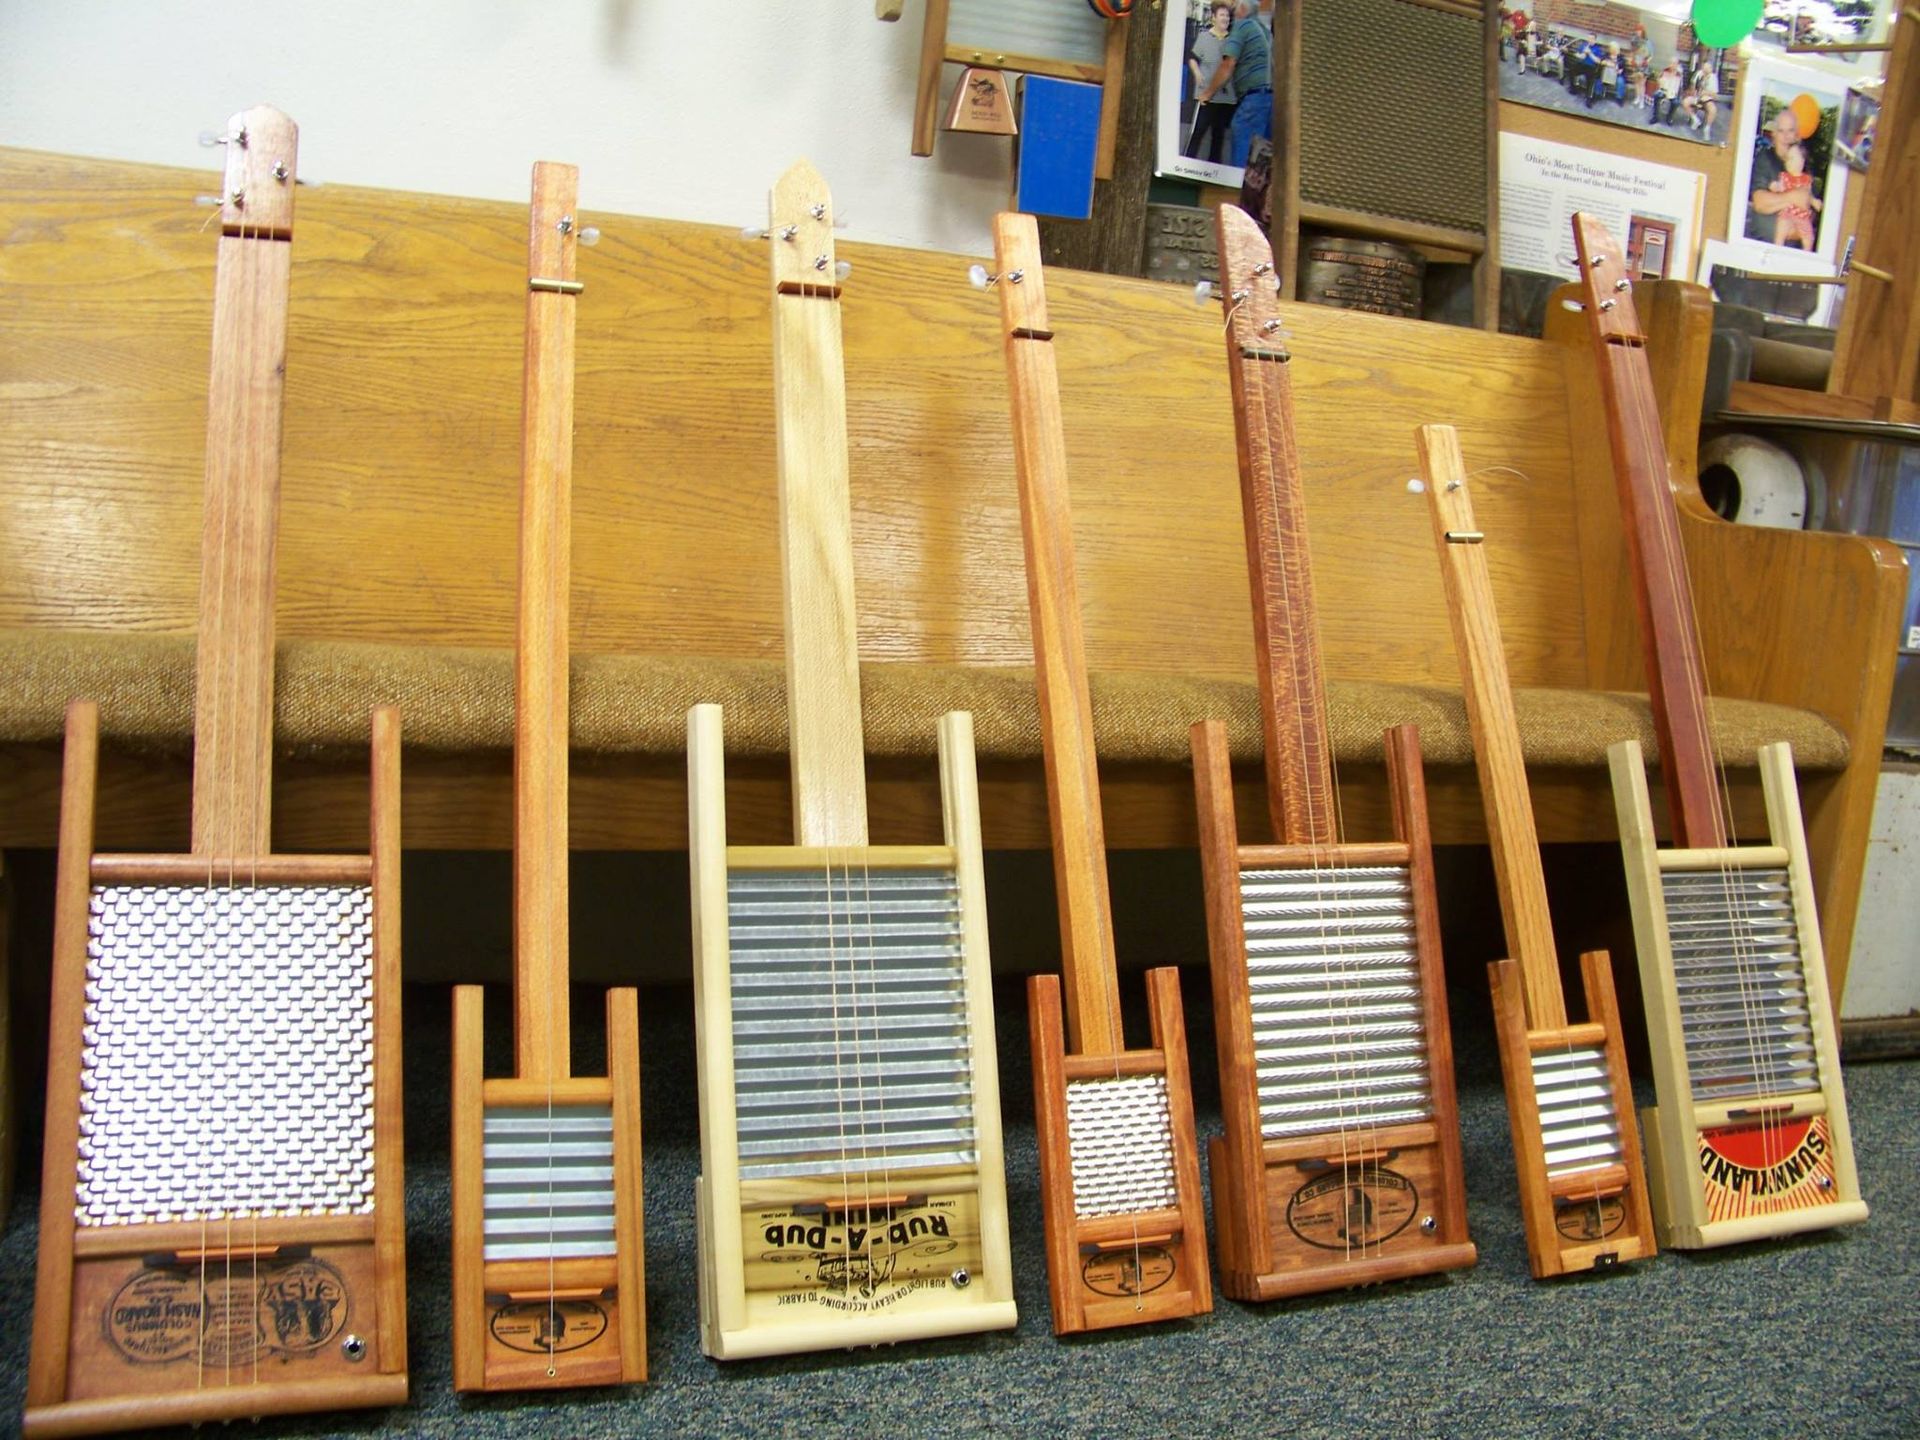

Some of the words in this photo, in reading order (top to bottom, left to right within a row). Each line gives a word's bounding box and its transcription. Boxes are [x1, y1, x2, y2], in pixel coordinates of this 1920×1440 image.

[1525, 152, 1551, 166] Ohio's
[1553, 159, 1574, 171] Most
[1576, 163, 1605, 178] Unique
[1608, 170, 1631, 182] Music
[1634, 175, 1666, 190] Festival
[1700, 1130, 1825, 1196] SUNNYLAND
[929, 1279, 946, 1289] RUB
[808, 1291, 818, 1302] TO
[896, 1286, 908, 1299] OR
[777, 1293, 806, 1306] FABRIC
